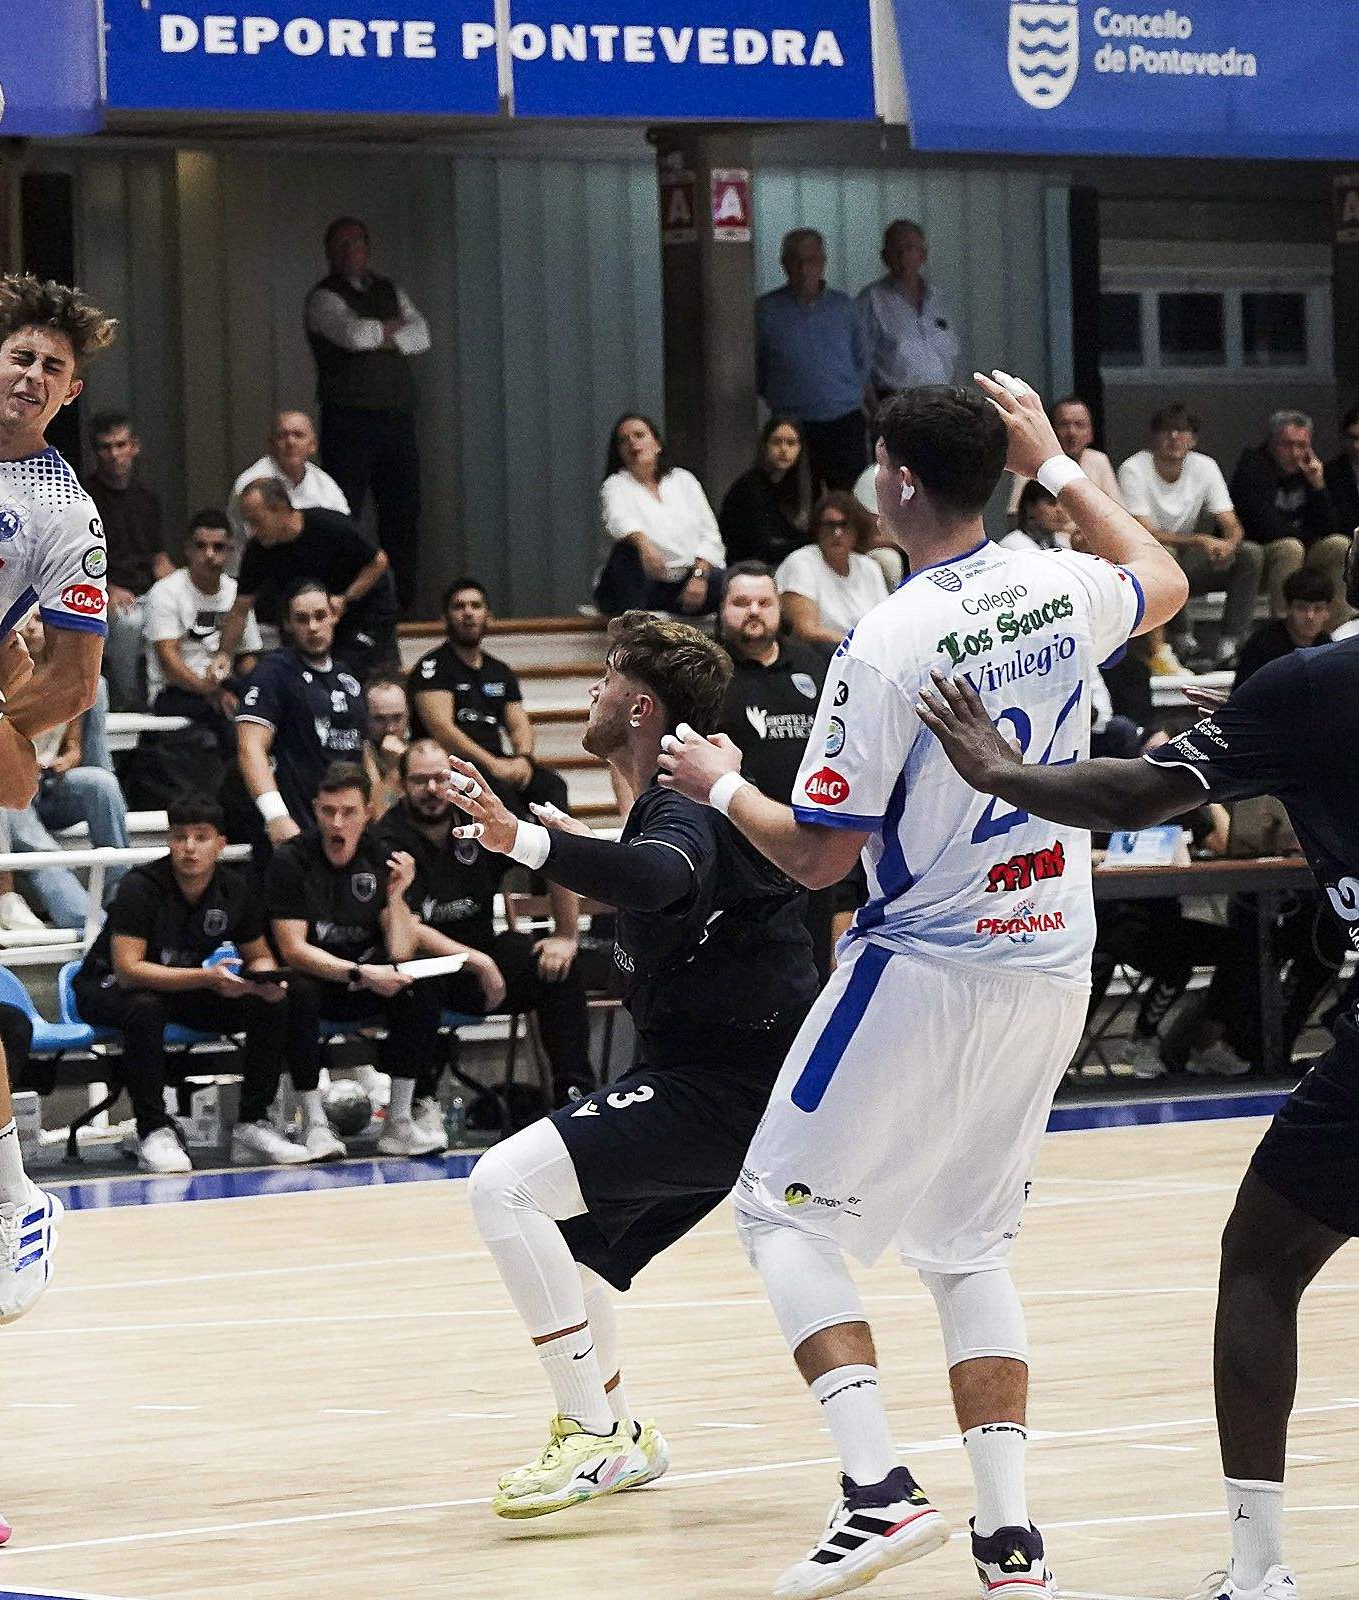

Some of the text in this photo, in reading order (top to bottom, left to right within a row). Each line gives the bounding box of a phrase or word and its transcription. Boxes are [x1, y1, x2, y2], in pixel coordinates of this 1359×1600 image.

[1093, 7, 1193, 40] Concello
[159, 15, 845, 67] DEPORTE PONTEVEDRA
[1094, 43, 1258, 77] de Pontevedra
[715, 184, 744, 221] A
[961, 582, 1028, 616] Colegio
[937, 594, 1074, 668] Los Sauces
[976, 911, 1066, 935] PESCAMAR
